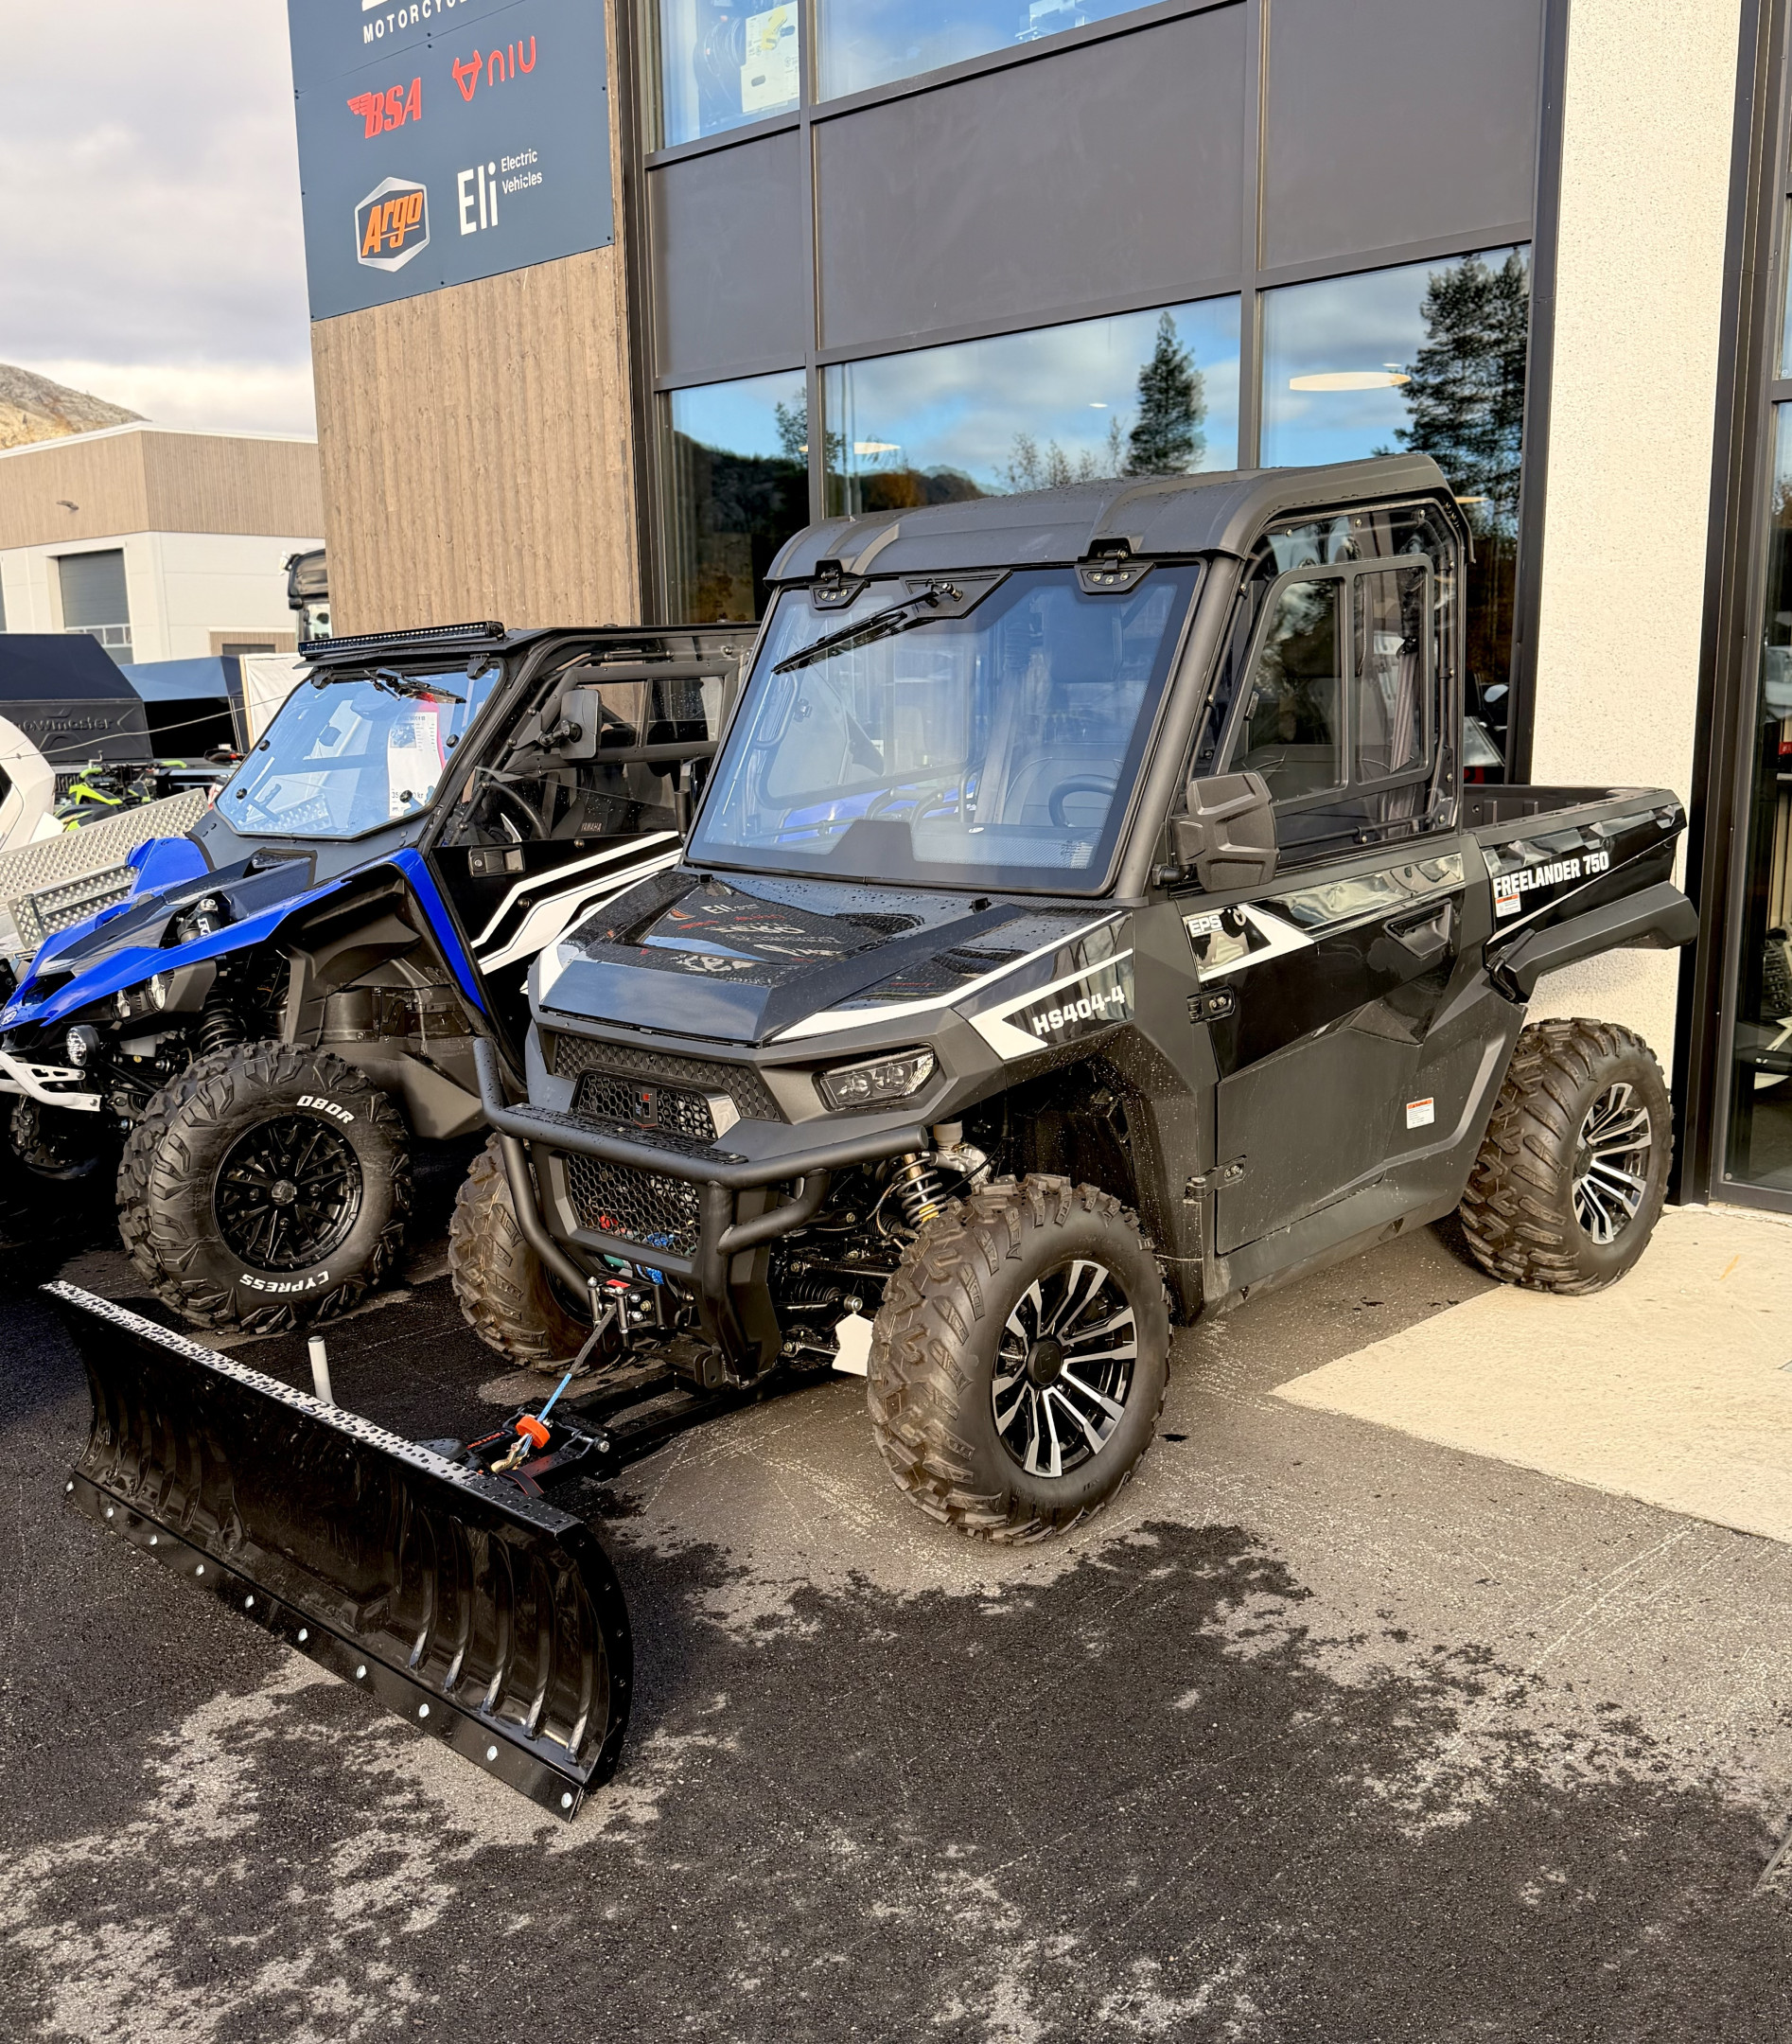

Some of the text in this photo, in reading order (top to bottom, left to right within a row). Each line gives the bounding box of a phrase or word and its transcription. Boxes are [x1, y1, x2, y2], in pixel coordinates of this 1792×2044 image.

[363, 0, 468, 44] MOTORCY
[363, 77, 422, 139] BSA
[501, 148, 538, 172] Electric
[501, 171, 543, 194] Vehicles
[458, 162, 499, 236] Eli
[362, 192, 423, 256] Argo
[1492, 851, 1609, 899] FREELANDER 750
[1187, 914, 1223, 935] EPS
[1032, 985, 1126, 1036] HS404-4
[239, 1270, 329, 1294] CYPRESS
